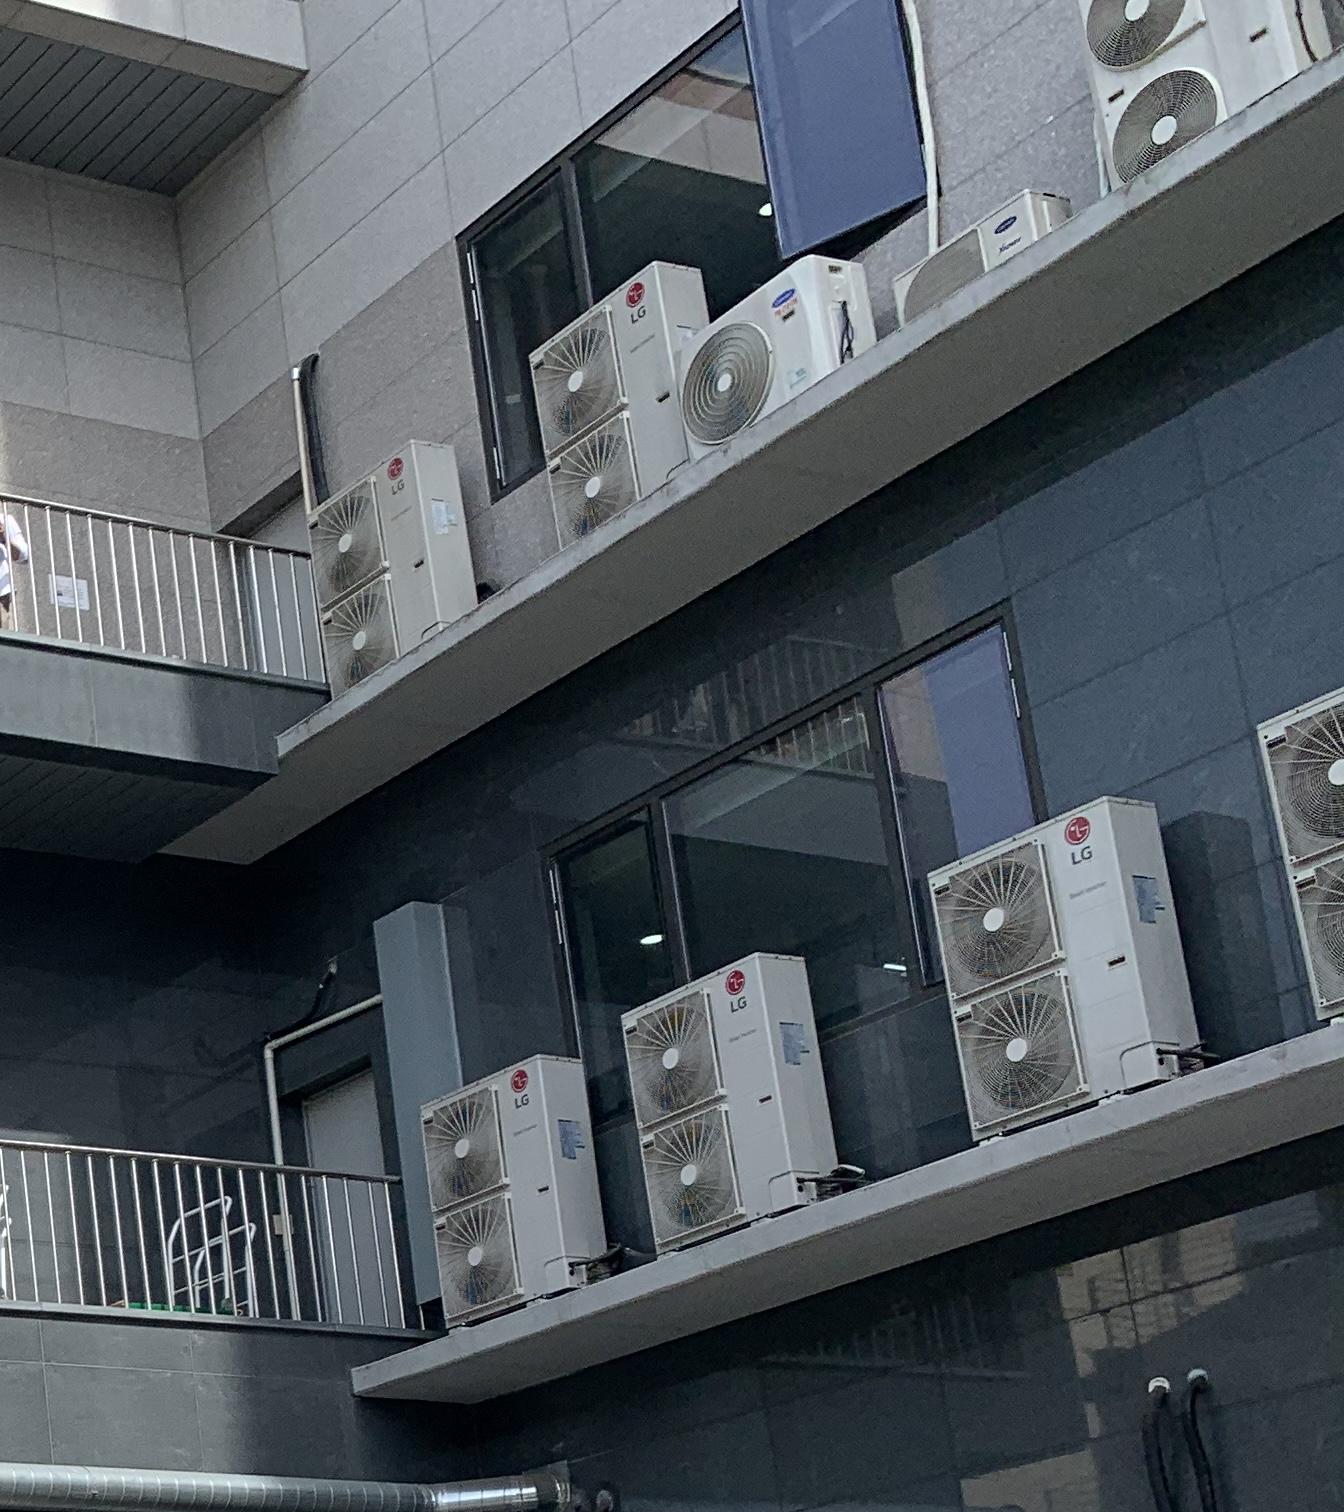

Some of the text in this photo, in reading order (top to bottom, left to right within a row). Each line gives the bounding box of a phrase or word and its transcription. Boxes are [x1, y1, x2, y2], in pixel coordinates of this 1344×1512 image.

[631, 305, 646, 324] LG
[391, 479, 405, 496] LG
[1070, 845, 1093, 866] LG
[729, 995, 748, 1013] LG
[514, 1093, 530, 1109] LG
